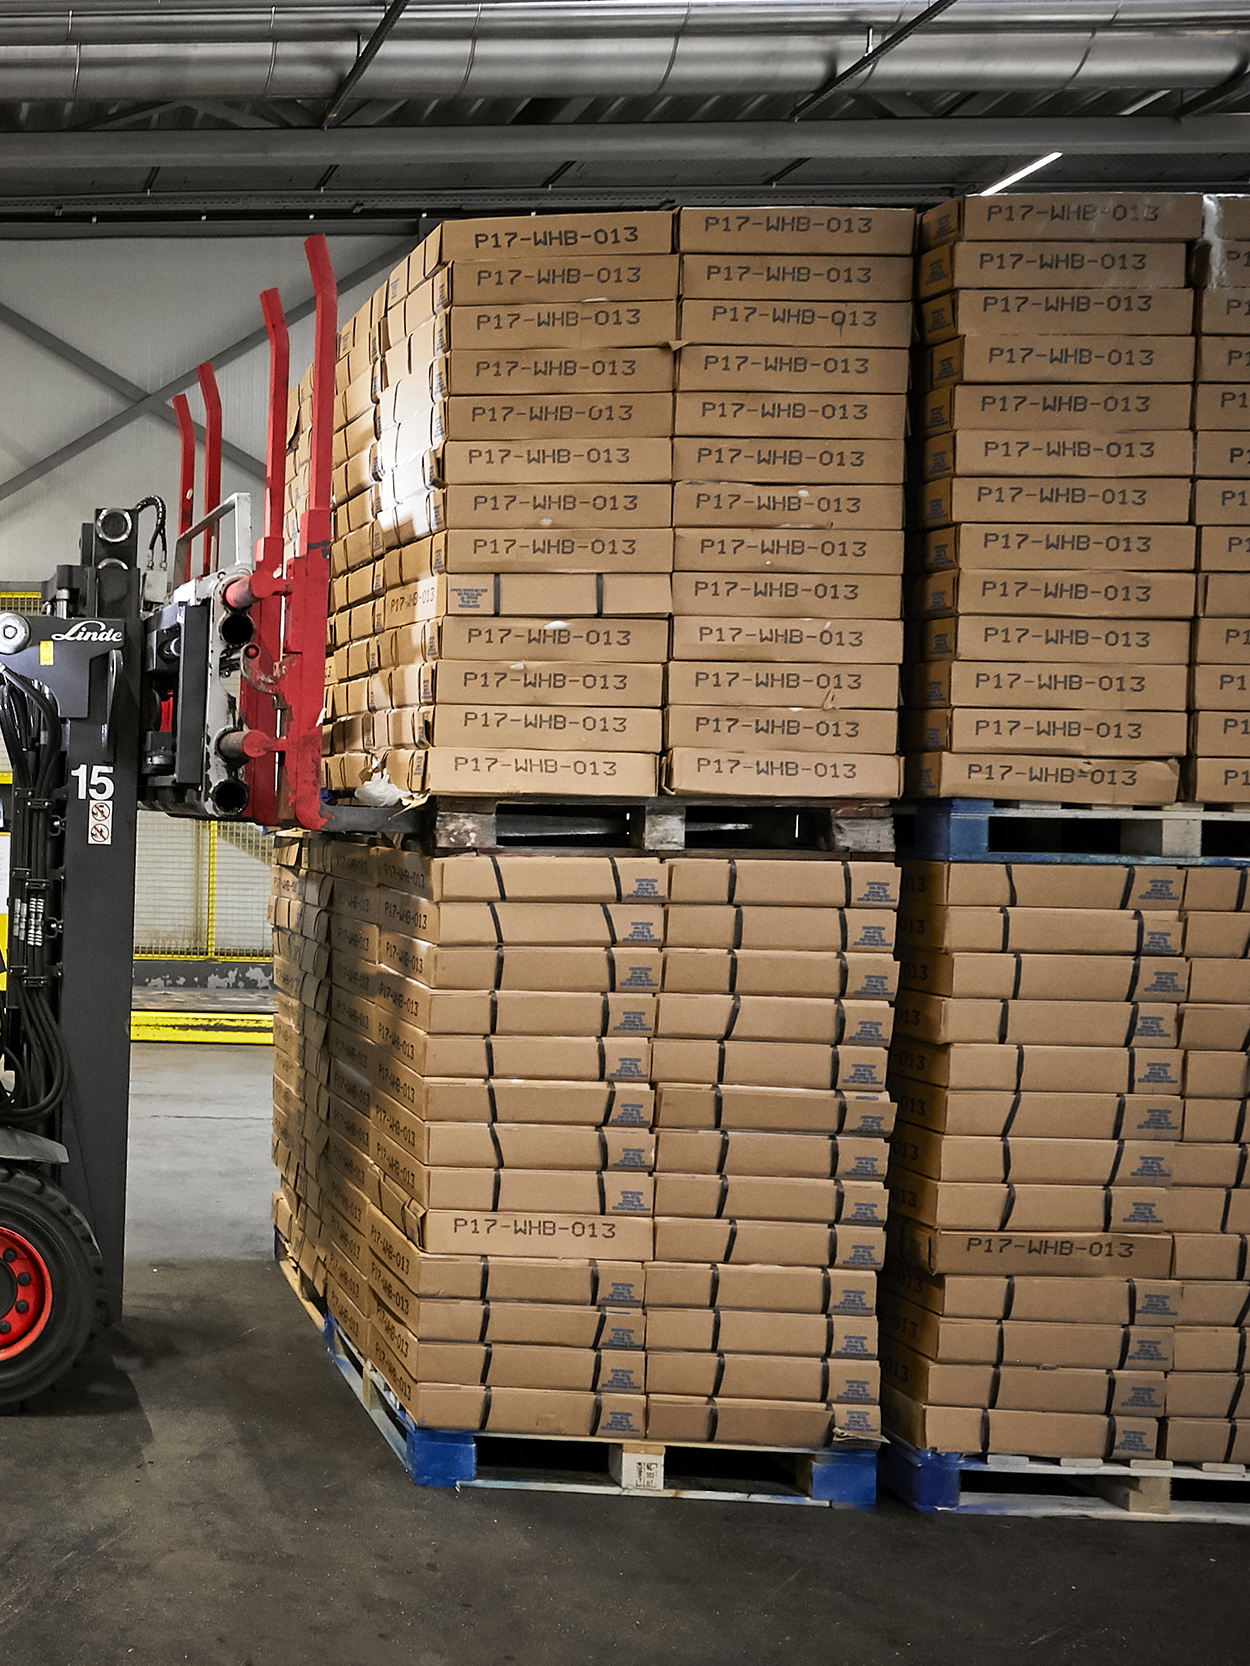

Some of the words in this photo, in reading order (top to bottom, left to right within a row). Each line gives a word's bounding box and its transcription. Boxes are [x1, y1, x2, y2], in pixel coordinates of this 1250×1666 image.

[986, 203, 1160, 223] P17-WHB-013
[704, 215, 873, 234] P17-WHB-013
[474, 226, 639, 249] P17-WHB-013
[978, 252, 1147, 271] P17-WHB-013
[476, 266, 642, 287] P17-WHB-013
[706, 264, 872, 284] P17-WHB-013
[982, 295, 1153, 314] P17-WHB-013
[476, 308, 641, 331] P17-WHB-013
[711, 305, 877, 326] P17-WHB-013
[703, 354, 869, 375] P17-WHB-013
[988, 346, 1155, 367] P17-WHB-013
[475, 359, 637, 377] P17-WHB-013
[471, 404, 634, 423] P17-WHB-013
[701, 401, 868, 421] P17-WHB-013
[980, 394, 1151, 413] P17-WHB-013
[468, 447, 630, 465] P17-WHB-013
[697, 447, 865, 468] P17-WHB-013
[983, 440, 1155, 459] P17-WHB-013
[473, 494, 639, 511] P17-WHB-013
[695, 492, 862, 514] P17-WHB-013
[976, 485, 1147, 507] P17-WHB-013
[473, 538, 637, 556] P17-WHB-013
[700, 538, 868, 558] P17-WHB-013
[983, 532, 1152, 553] P17-WHB-013
[694, 580, 859, 601] P17-WHB-013
[981, 580, 1152, 603] P17-WHB-013
[51, 620, 123, 642] Linde
[467, 627, 632, 647] P17-WHB-013
[698, 626, 863, 648] P17-WHB-013
[983, 626, 1151, 648] P17-WHB-013
[463, 670, 628, 691] P17-WHB-013
[694, 671, 862, 690] P17-WHB-013
[975, 672, 1146, 693] P17-WHB-013
[463, 711, 628, 733] P17-WHB-013
[695, 716, 860, 738] P17-WHB-013
[974, 719, 1143, 740] P17-WHB-013
[454, 757, 618, 777] P17-WHB-013
[696, 758, 858, 780] P17-WHB-013
[967, 760, 1138, 787] P17-WHB-013
[71, 764, 115, 801] 15
[384, 902, 427, 929] P17-WHB-013
[375, 1104, 415, 1146] P17-WHB-013
[376, 1142, 415, 1188] P17-WHB-013
[453, 1217, 616, 1239] P17-WHB-013
[370, 1224, 409, 1274] P17-WHB-013
[966, 1237, 1134, 1259] P17-WHB-013
[370, 1261, 409, 1315] P17-WHB-013
[376, 1300, 409, 1357] P17-WHB-013
